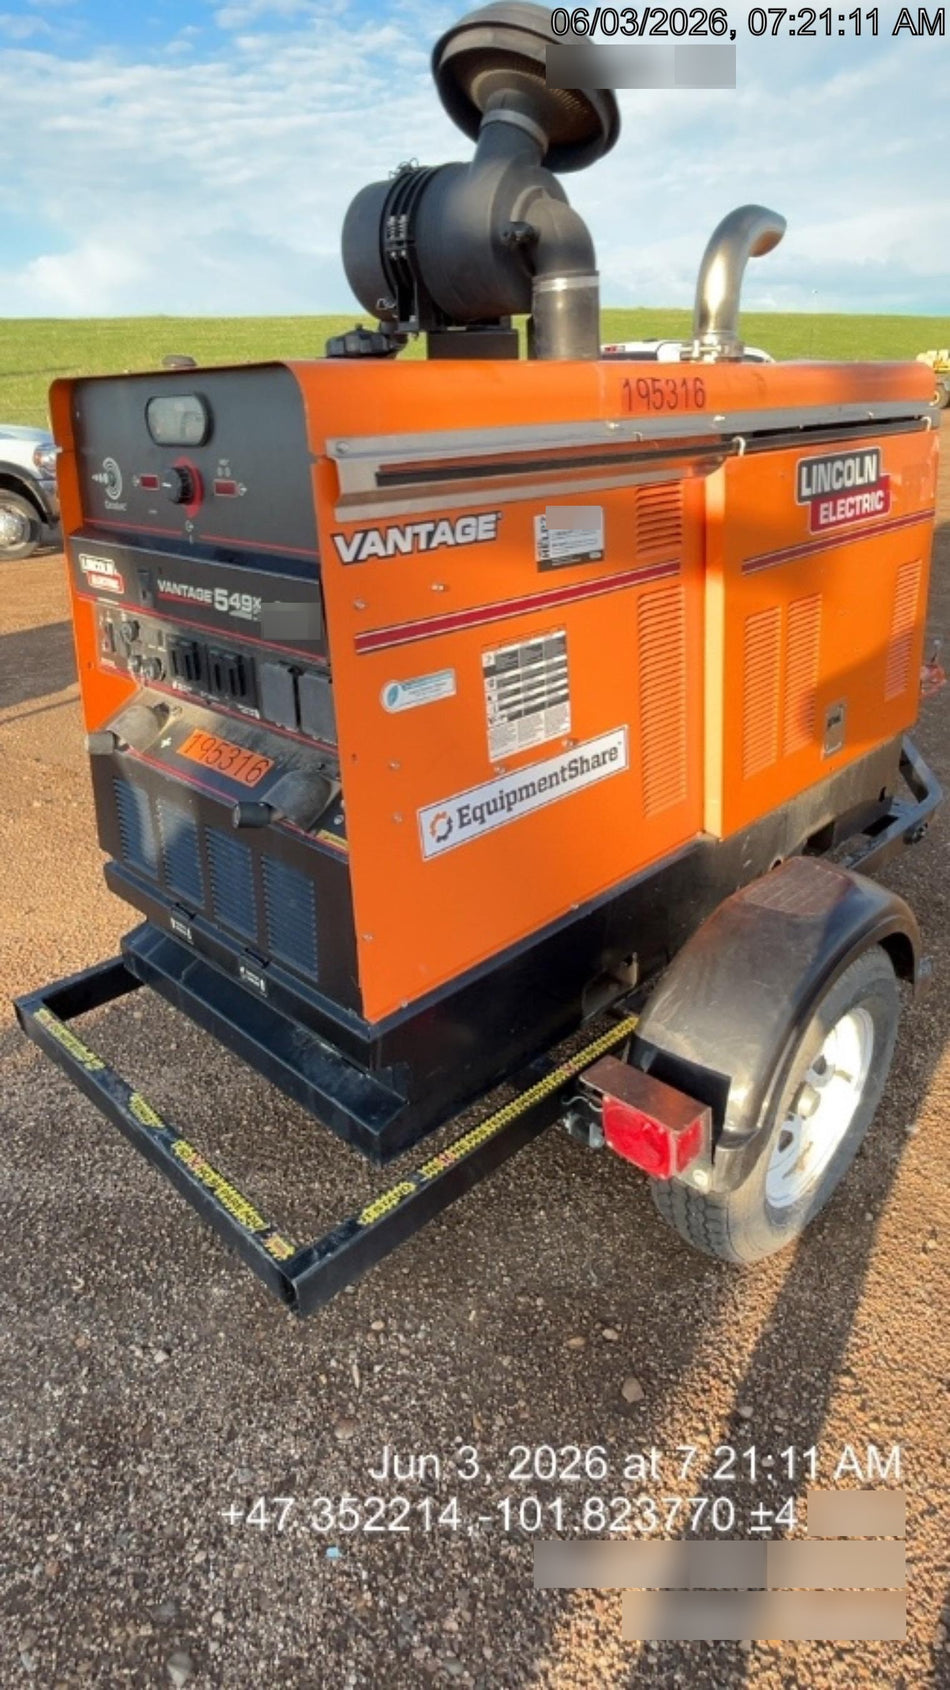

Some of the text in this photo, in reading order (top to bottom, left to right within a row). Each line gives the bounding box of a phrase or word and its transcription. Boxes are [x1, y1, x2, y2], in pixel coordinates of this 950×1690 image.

[623, 377, 707, 411] 195316
[800, 453, 877, 497] LINCOLN
[818, 490, 884, 525] ELECTRIC
[332, 512, 498, 564] VANTAGE
[157, 579, 213, 603] VANTAGE
[184, 733, 269, 783] 195316
[457, 745, 619, 830] EquipmentShare
